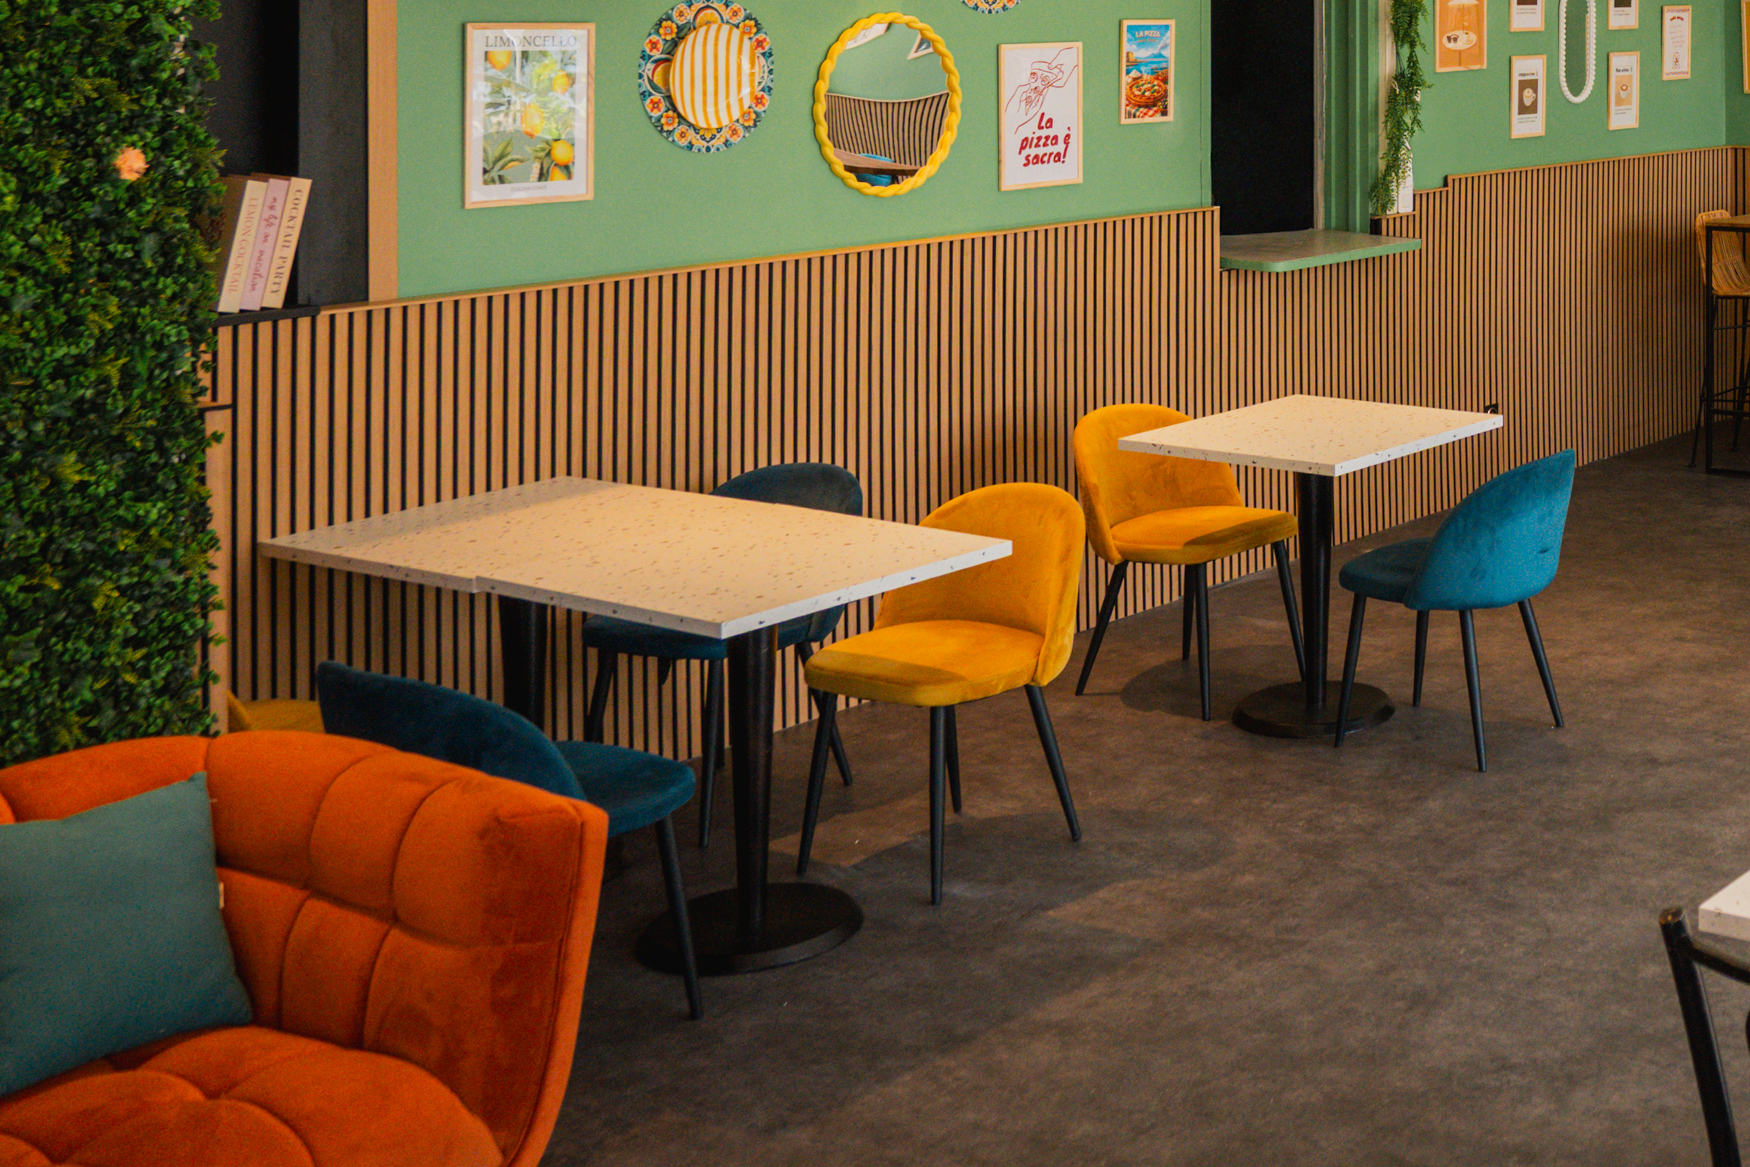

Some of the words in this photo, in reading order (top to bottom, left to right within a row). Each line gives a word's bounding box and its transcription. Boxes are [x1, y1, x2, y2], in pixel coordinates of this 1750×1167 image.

[485, 35, 578, 48] LIMONCELLO
[1145, 30, 1161, 38] PIZZA
[1037, 112, 1054, 130] La
[1018, 131, 1059, 155] pizza
[1063, 126, 1072, 146] è
[1022, 142, 1070, 167] sacra!
[242, 196, 259, 236] LEMON
[281, 188, 304, 249] COCKTAIL
[228, 238, 251, 293] COCKTAIL
[270, 255, 288, 294] PARTY
